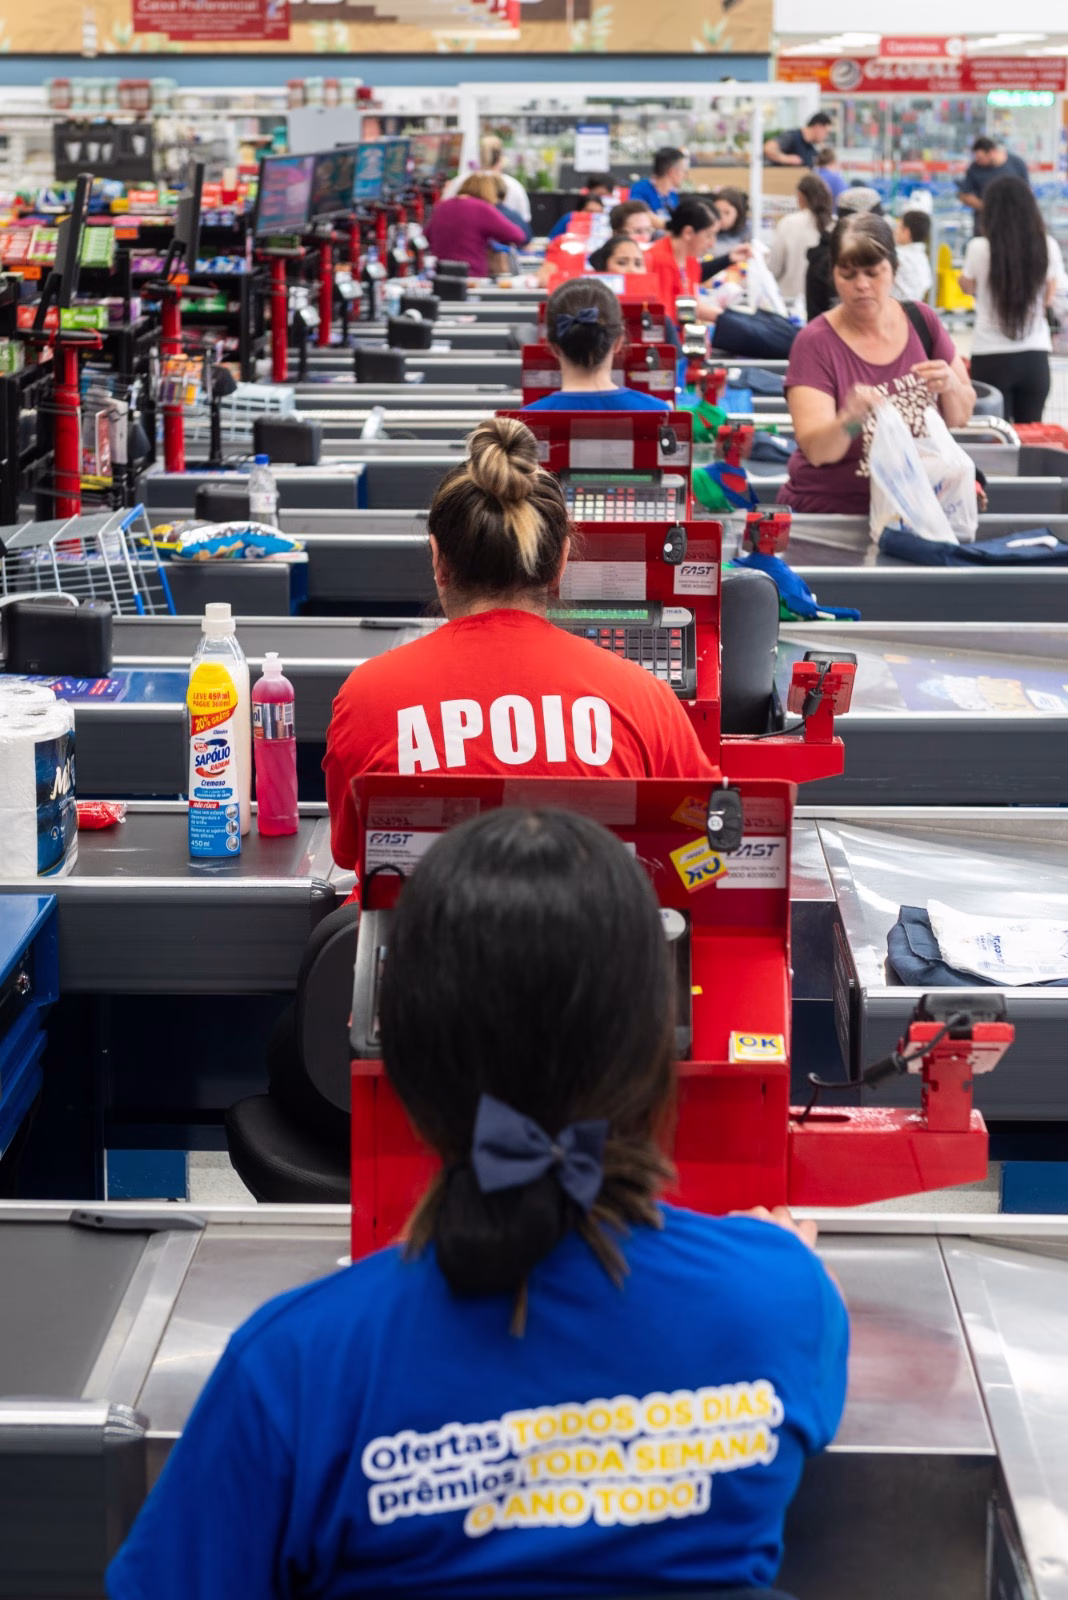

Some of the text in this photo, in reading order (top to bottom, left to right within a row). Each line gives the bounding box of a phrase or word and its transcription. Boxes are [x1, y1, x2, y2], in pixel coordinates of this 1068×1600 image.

[680, 565, 715, 575] FAST
[195, 709, 230, 731] 20% GRÁTIS
[397, 694, 613, 776] APOIO
[195, 746, 231, 767] SAPÓLIO
[201, 779, 226, 787] Cremoso
[370, 832, 413, 845] FAST
[727, 843, 780, 857] AST
[372, 1431, 501, 1470] Ofertas
[512, 1405, 635, 1444] TODOS
[646, 1399, 693, 1428] OS
[527, 1448, 626, 1477] TODA
[470, 1480, 703, 1529] O ANO TODO!
